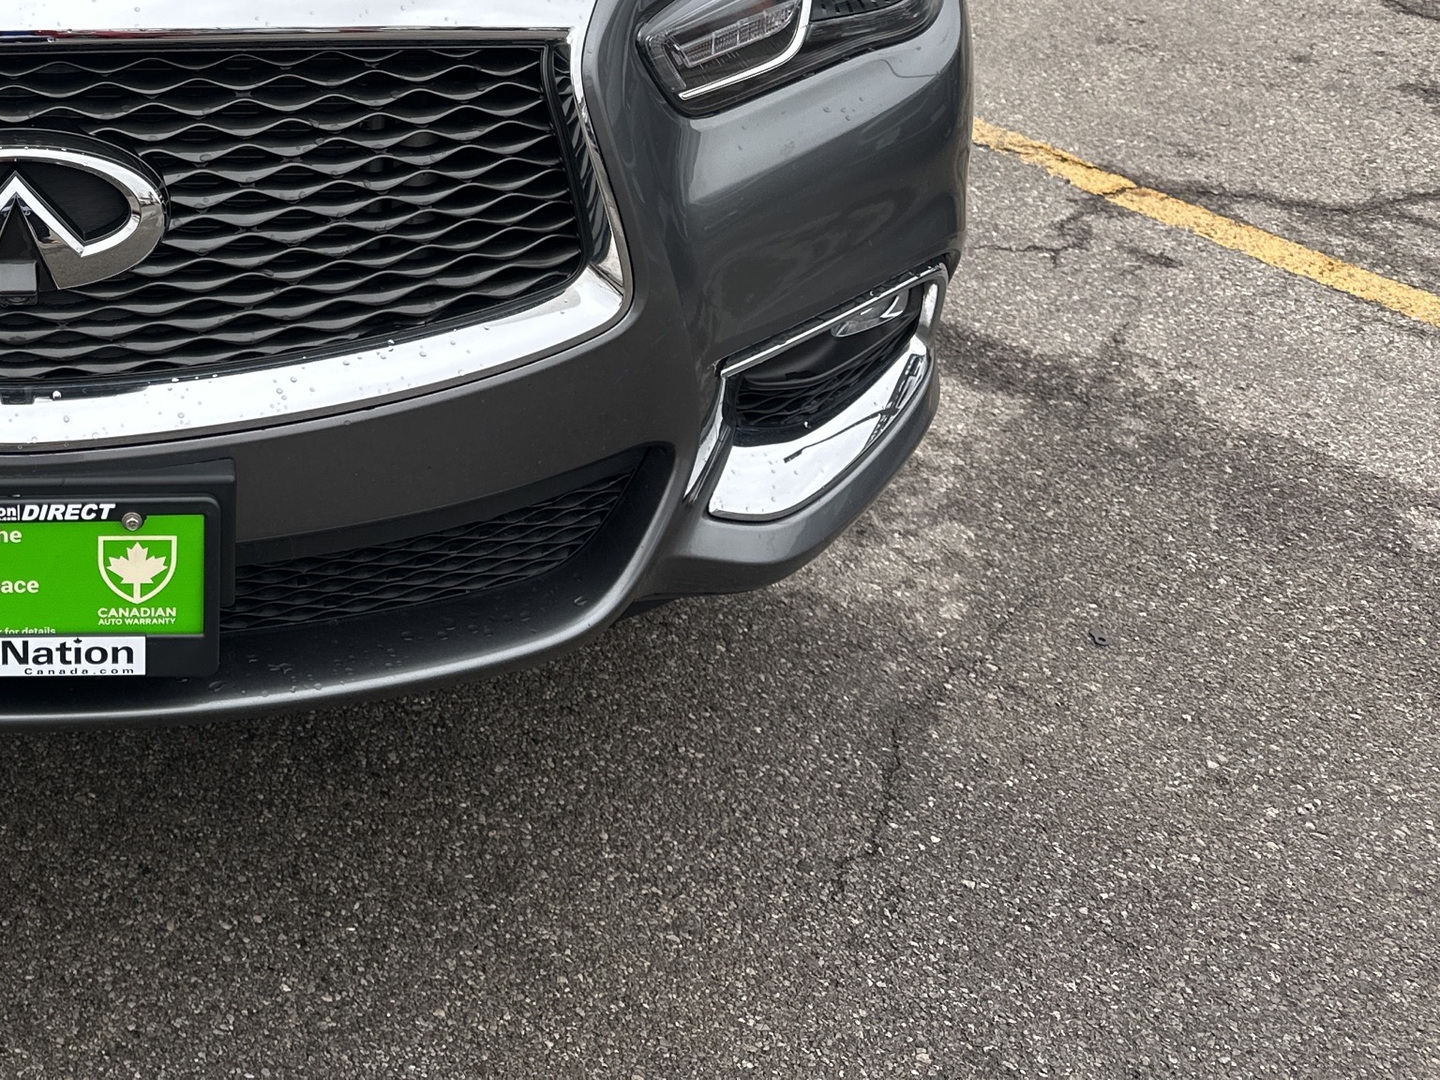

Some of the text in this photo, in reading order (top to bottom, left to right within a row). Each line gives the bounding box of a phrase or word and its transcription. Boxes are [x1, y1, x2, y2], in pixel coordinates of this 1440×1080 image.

[21, 503, 116, 521] DIRECT
[97, 606, 176, 618] CANADIAN
[98, 617, 176, 626] AUTO WARRANTY
[4, 627, 19, 635] for
